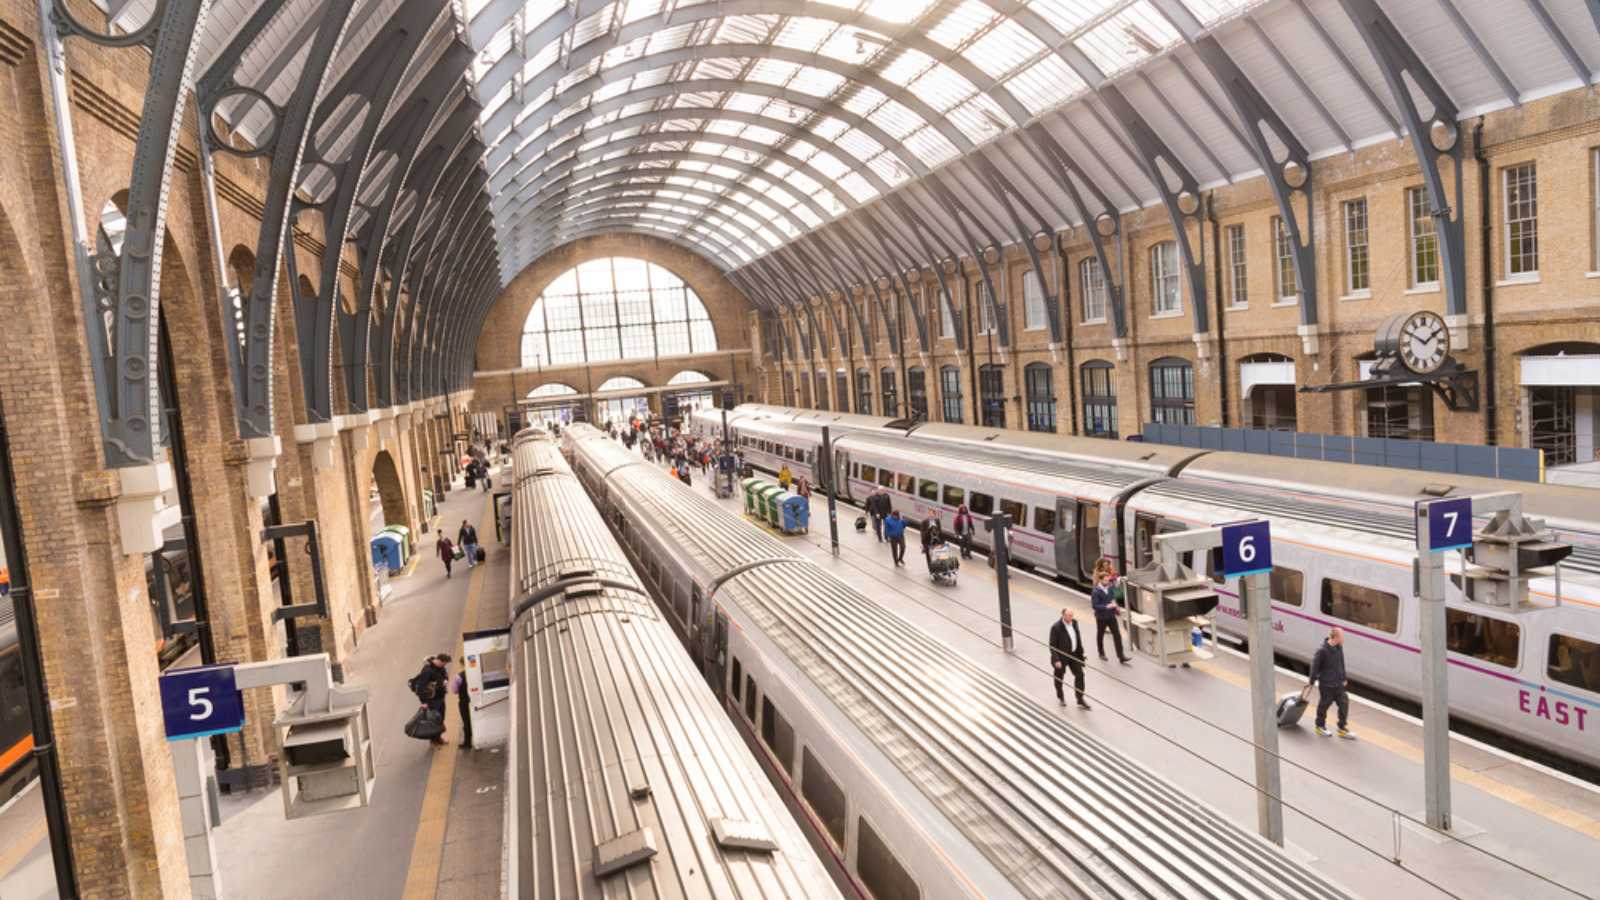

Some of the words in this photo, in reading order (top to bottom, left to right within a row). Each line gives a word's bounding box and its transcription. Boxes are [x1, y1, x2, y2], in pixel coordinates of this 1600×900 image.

[1443, 512, 1459, 538] 7
[1239, 535, 1256, 562] 6
[188, 686, 213, 720] 5
[1519, 688, 1588, 731] EAST
